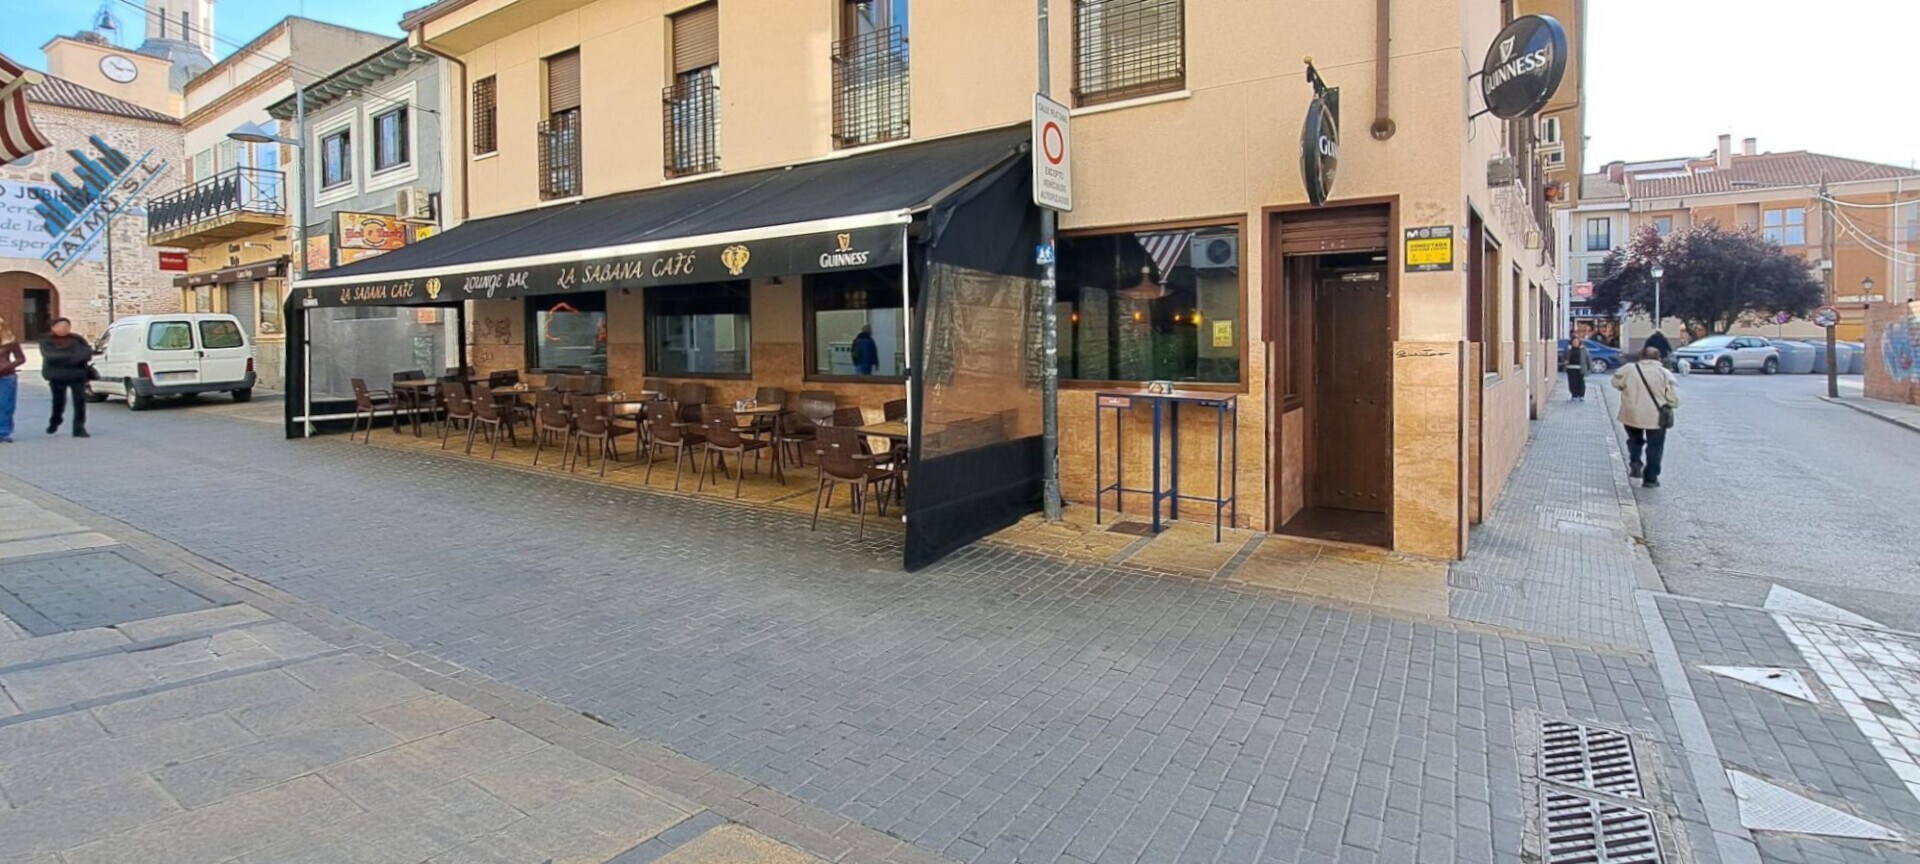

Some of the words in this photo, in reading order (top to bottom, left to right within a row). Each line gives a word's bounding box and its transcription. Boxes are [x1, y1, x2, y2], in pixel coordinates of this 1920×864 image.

[1485, 48, 1547, 95] GUINNESS
[1045, 166, 1064, 180] EXCEPTO
[557, 267, 577, 290] LA
[581, 260, 644, 285] SABANA
[651, 250, 696, 278] CAFÉ
[819, 250, 870, 269] GUINNESS
[340, 287, 351, 305] LA
[354, 285, 387, 301] SABANA
[391, 280, 415, 299] CAFÉ
[463, 273, 504, 298] LOUNGE
[506, 271, 529, 290] BAR
